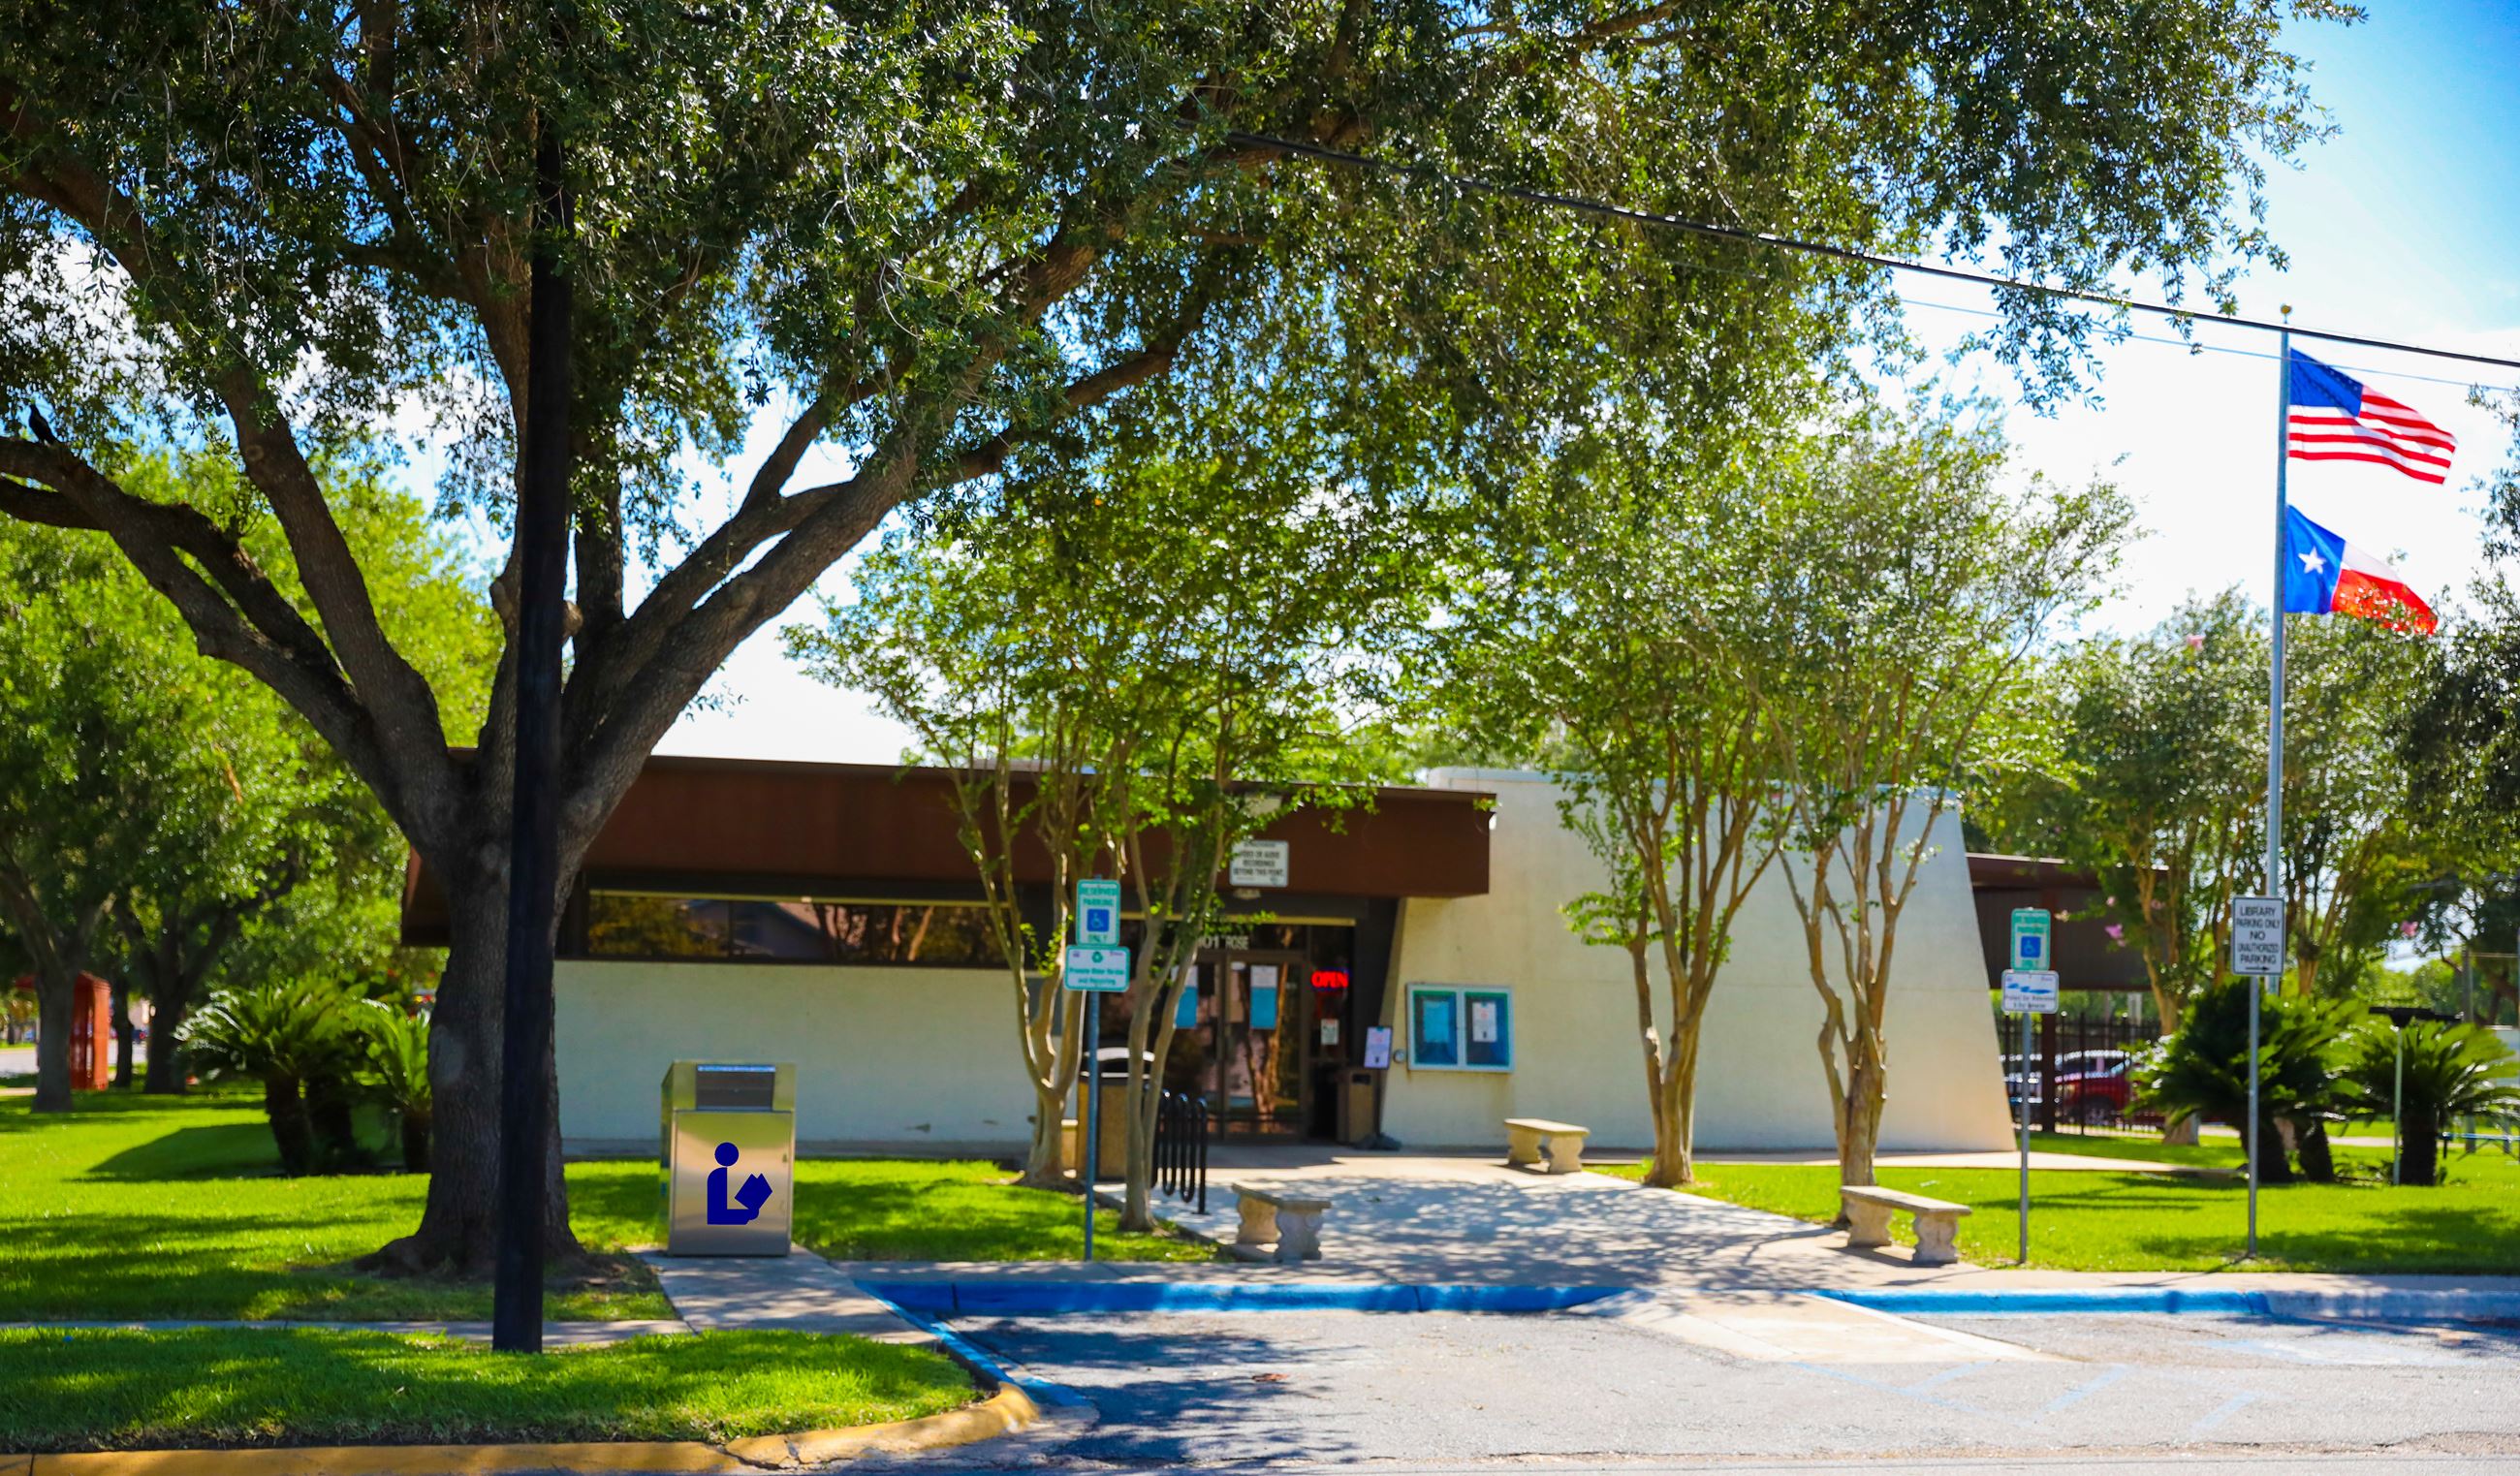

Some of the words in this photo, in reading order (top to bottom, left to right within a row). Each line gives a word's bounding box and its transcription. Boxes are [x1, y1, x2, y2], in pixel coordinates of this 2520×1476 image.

[2240, 906, 2277, 917] LIBRARY
[2236, 918, 2264, 928] PARKING
[2264, 919, 2281, 929] ONLY
[2250, 930, 2266, 940] NO
[2237, 942, 2280, 953] UNAUTHORIZED
[2240, 954, 2277, 964] PARKING
[1311, 970, 1348, 989] OPEN
